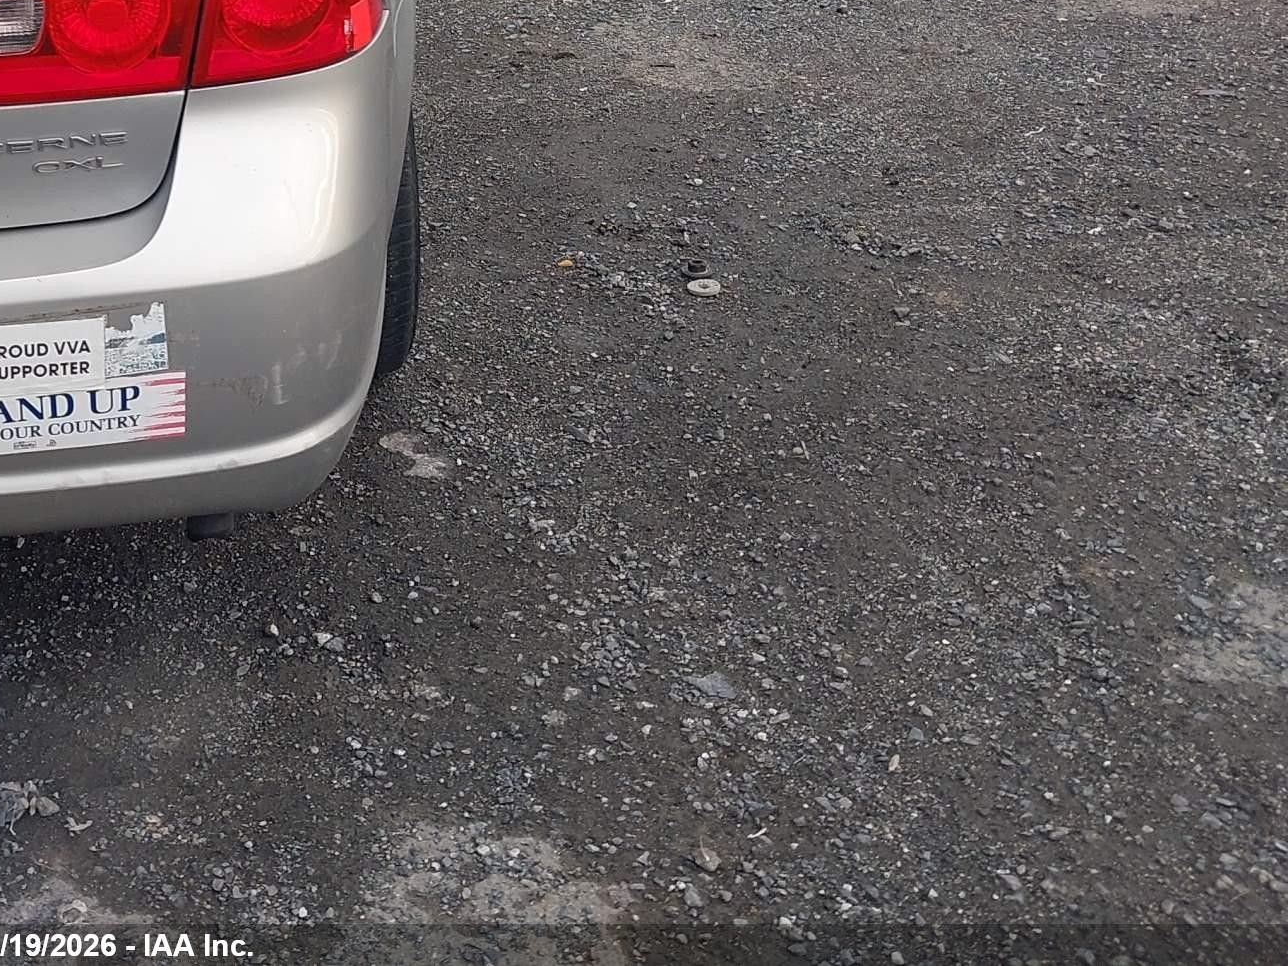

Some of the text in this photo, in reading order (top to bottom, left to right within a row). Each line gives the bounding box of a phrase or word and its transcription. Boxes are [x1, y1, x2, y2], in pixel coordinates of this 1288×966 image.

[32, 156, 124, 173] CXL
[53, 340, 91, 355] VVA
[86, 385, 141, 414] UP
[48, 414, 142, 435] COUNTRY
